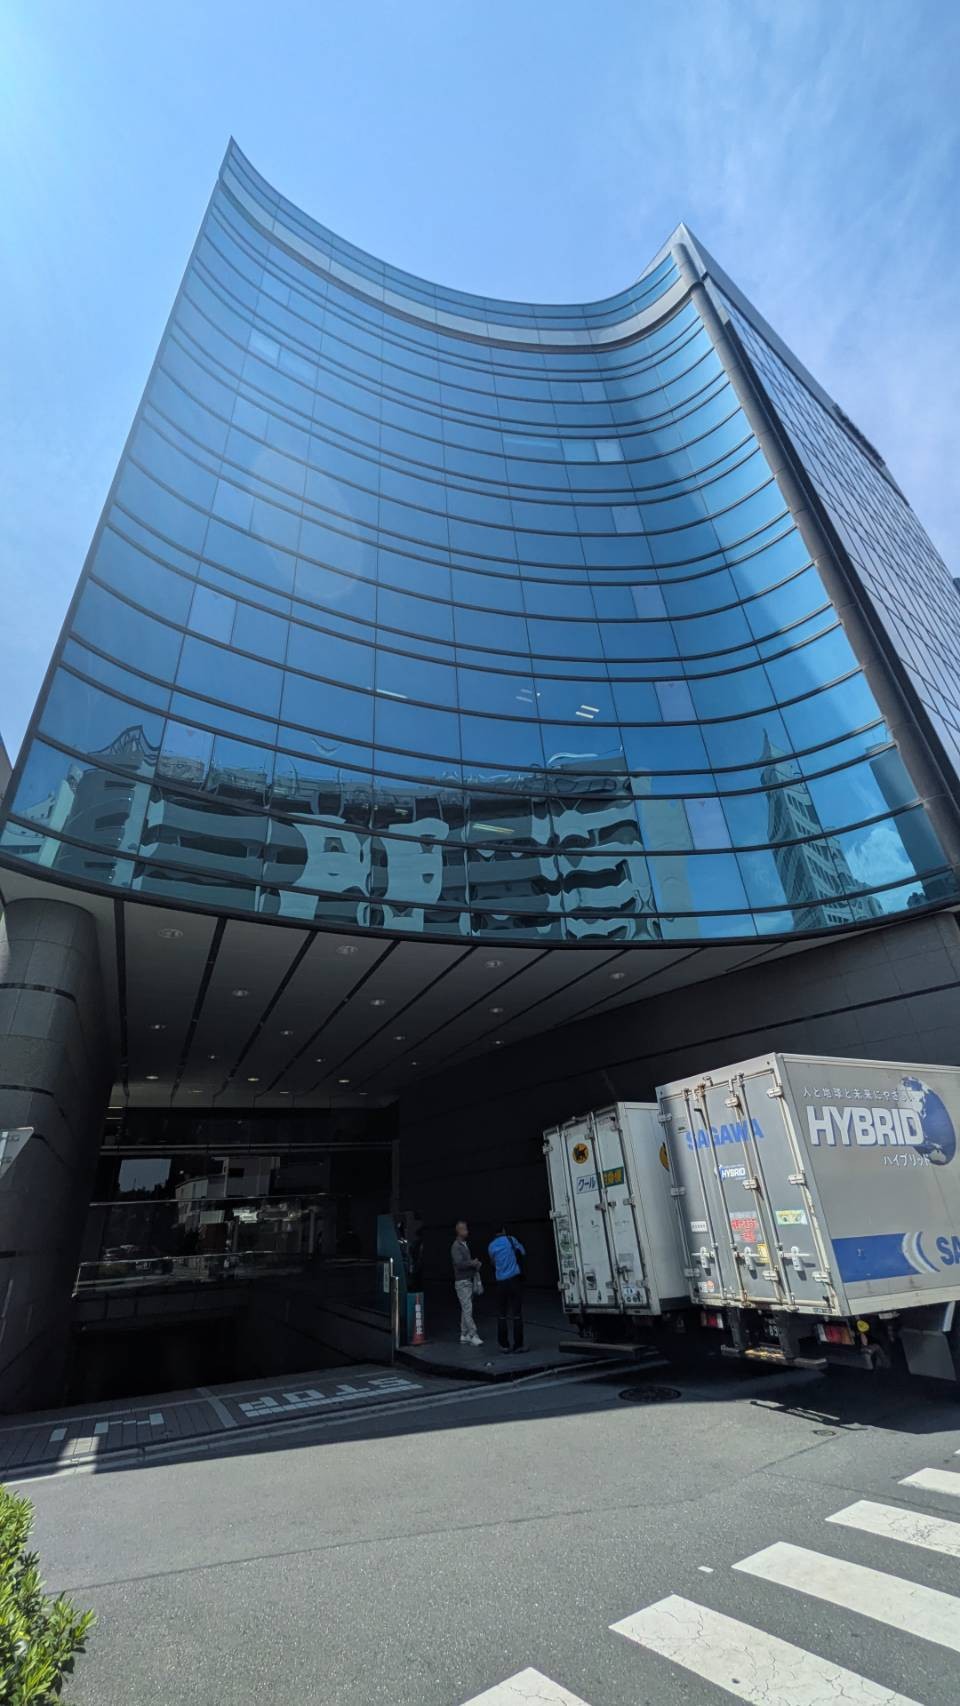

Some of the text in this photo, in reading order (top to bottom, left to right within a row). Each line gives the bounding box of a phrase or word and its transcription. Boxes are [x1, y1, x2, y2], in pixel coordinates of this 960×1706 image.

[685, 1118, 764, 1151] SAGAWA
[806, 1105, 925, 1146] HYBRID
[721, 1168, 746, 1178] HYBRID
[883, 1152, 930, 1167] ハイブリッド
[238, 1376, 412, 1412] STOP
